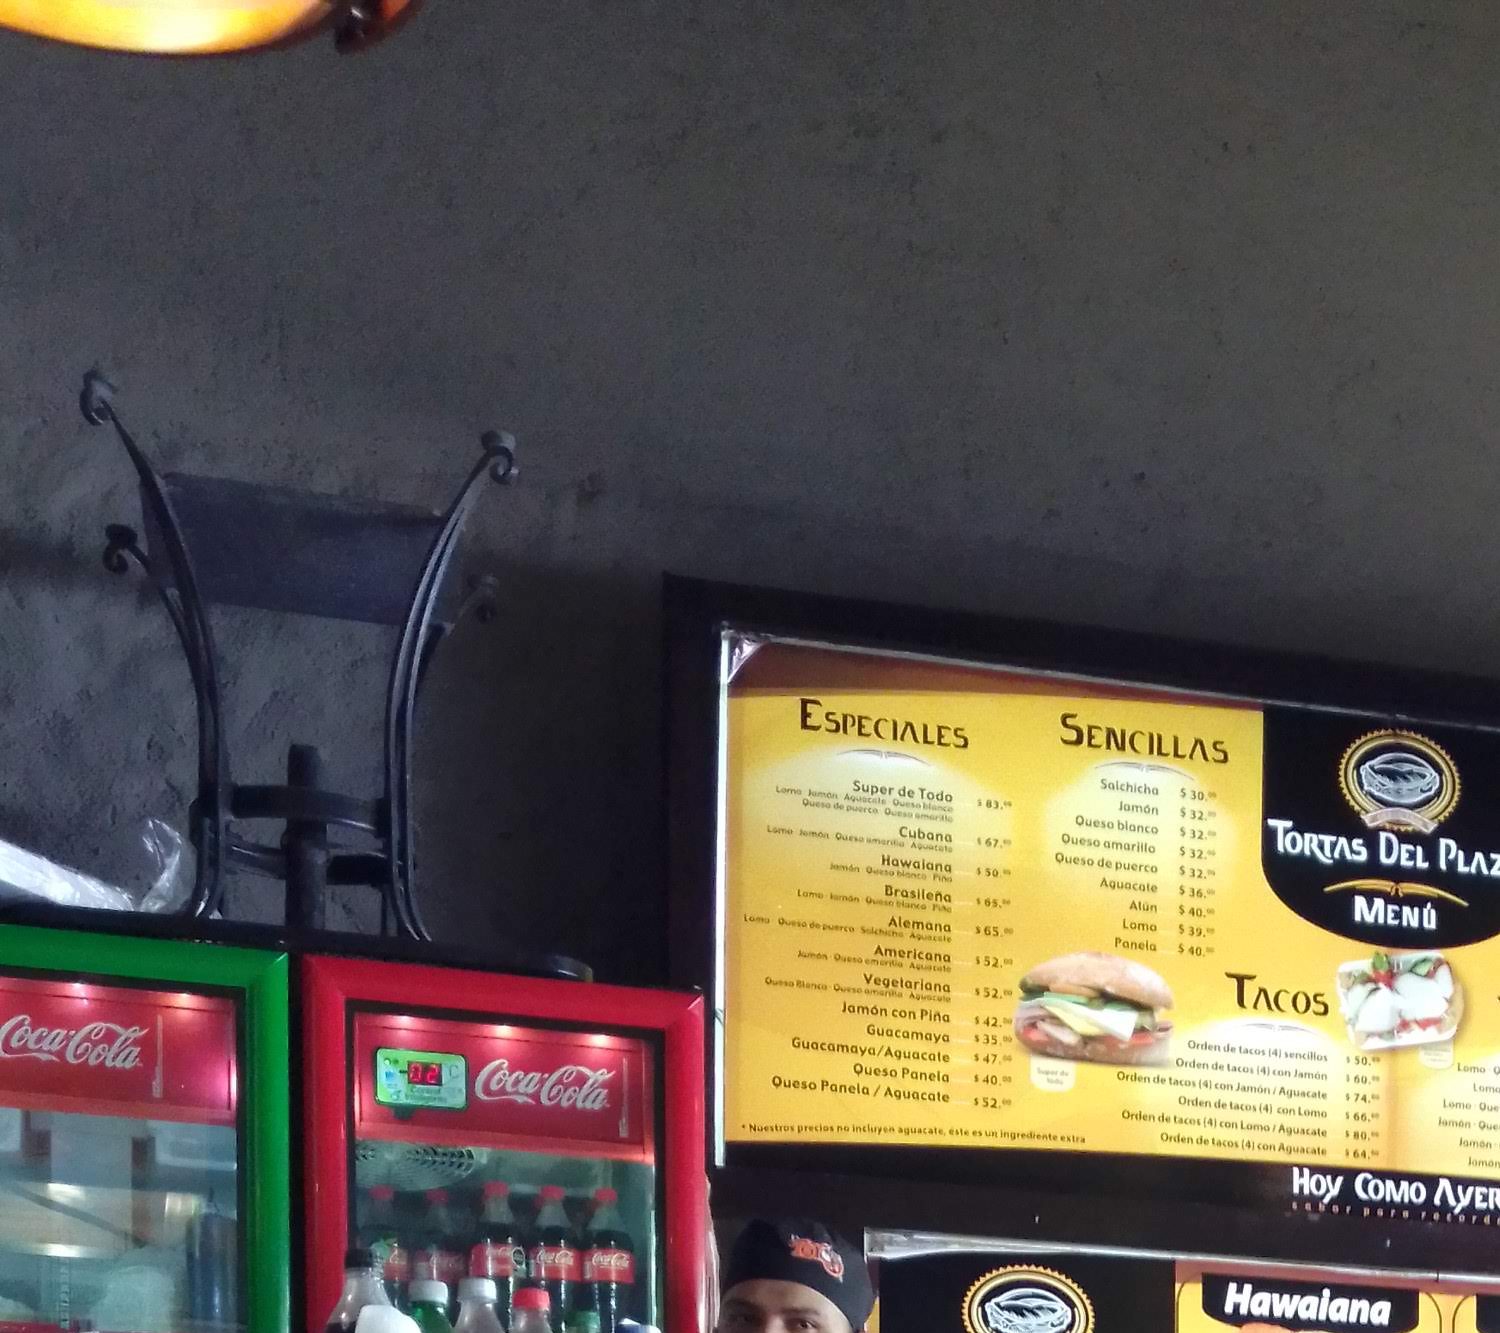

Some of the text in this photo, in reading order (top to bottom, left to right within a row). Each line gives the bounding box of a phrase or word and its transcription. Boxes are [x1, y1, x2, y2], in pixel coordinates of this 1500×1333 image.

[853, 780, 953, 803] Super de Todo
[1100, 779, 1159, 795] Salchicha
[1119, 801, 1158, 815] Jamón
[899, 826, 952, 843] Cubana
[1076, 815, 1158, 835] Queso blanco
[1062, 833, 1156, 853] Queso amarillo
[1267, 819, 1367, 863] TORTAS
[1379, 831, 1429, 869] DEL
[881, 855, 952, 873] Hawaiana
[1055, 852, 1158, 873] Queso de puerco
[885, 885, 951, 903] Brasileña
[1100, 878, 1158, 893] Aguacate
[888, 916, 951, 933] Alemana
[1123, 918, 1157, 932] Lomo
[874, 945, 951, 963] Americana
[1115, 937, 1157, 951] Panela
[864, 974, 951, 993] Vegetariana
[1225, 971, 1329, 1016] TACOS
[843, 1001, 950, 1023] Jamón con Piña
[0, 1014, 150, 1069] Coca-Cola
[867, 1024, 950, 1043] Guacamaya
[1188, 1040, 1328, 1062] Orden de tacos (4) sencillos
[853, 1063, 949, 1083] Queso Panela
[1176, 1058, 1327, 1080] Orden de tacos (4) con Jamón
[1457, 1063, 1486, 1074] Lomo
[474, 1058, 615, 1110] Coca-Cola
[772, 1075, 817, 1091] Queso
[821, 1080, 869, 1096] Panela
[884, 1086, 950, 1103] Aguacate
[1117, 1071, 1150, 1083] Orden
[1154, 1074, 1166, 1085] de
[1169, 1076, 1196, 1088] tacos
[1199, 1079, 1212, 1090] (4)
[1214, 1081, 1233, 1091] con
[1236, 1081, 1270, 1095] Jamón
[1279, 1087, 1327, 1100] Aguacate
[1474, 1083, 1500, 1094] Lomo
[1179, 1096, 1327, 1118] Orden de tacos (4) con Lomo
[1443, 1099, 1471, 1110] Lomo
[749, 1123, 794, 1133] Nuestros
[797, 1124, 833, 1135] precios
[837, 1125, 850, 1133] no
[852, 1124, 895, 1135] incluyen
[985, 1130, 997, 1138] un
[1000, 1130, 1057, 1142] ingrediente
[1060, 1134, 1085, 1144] extra
[1122, 1110, 1155, 1122] Orden
[1159, 1113, 1171, 1123] de
[1174, 1115, 1201, 1125] tacos
[1204, 1117, 1217, 1128] (4)
[1220, 1119, 1238, 1129] con
[1241, 1120, 1270, 1132] Lomo
[1279, 1124, 1327, 1137] Aguacate
[1160, 1132, 1327, 1157] Orden de tacos (4) con Aguacate
[1355, 1173, 1426, 1204] COMO
[1292, 1202, 1351, 1214] sabor
[1363, 1207, 1409, 1218] para
[1224, 1282, 1392, 1328] Hawaiana
